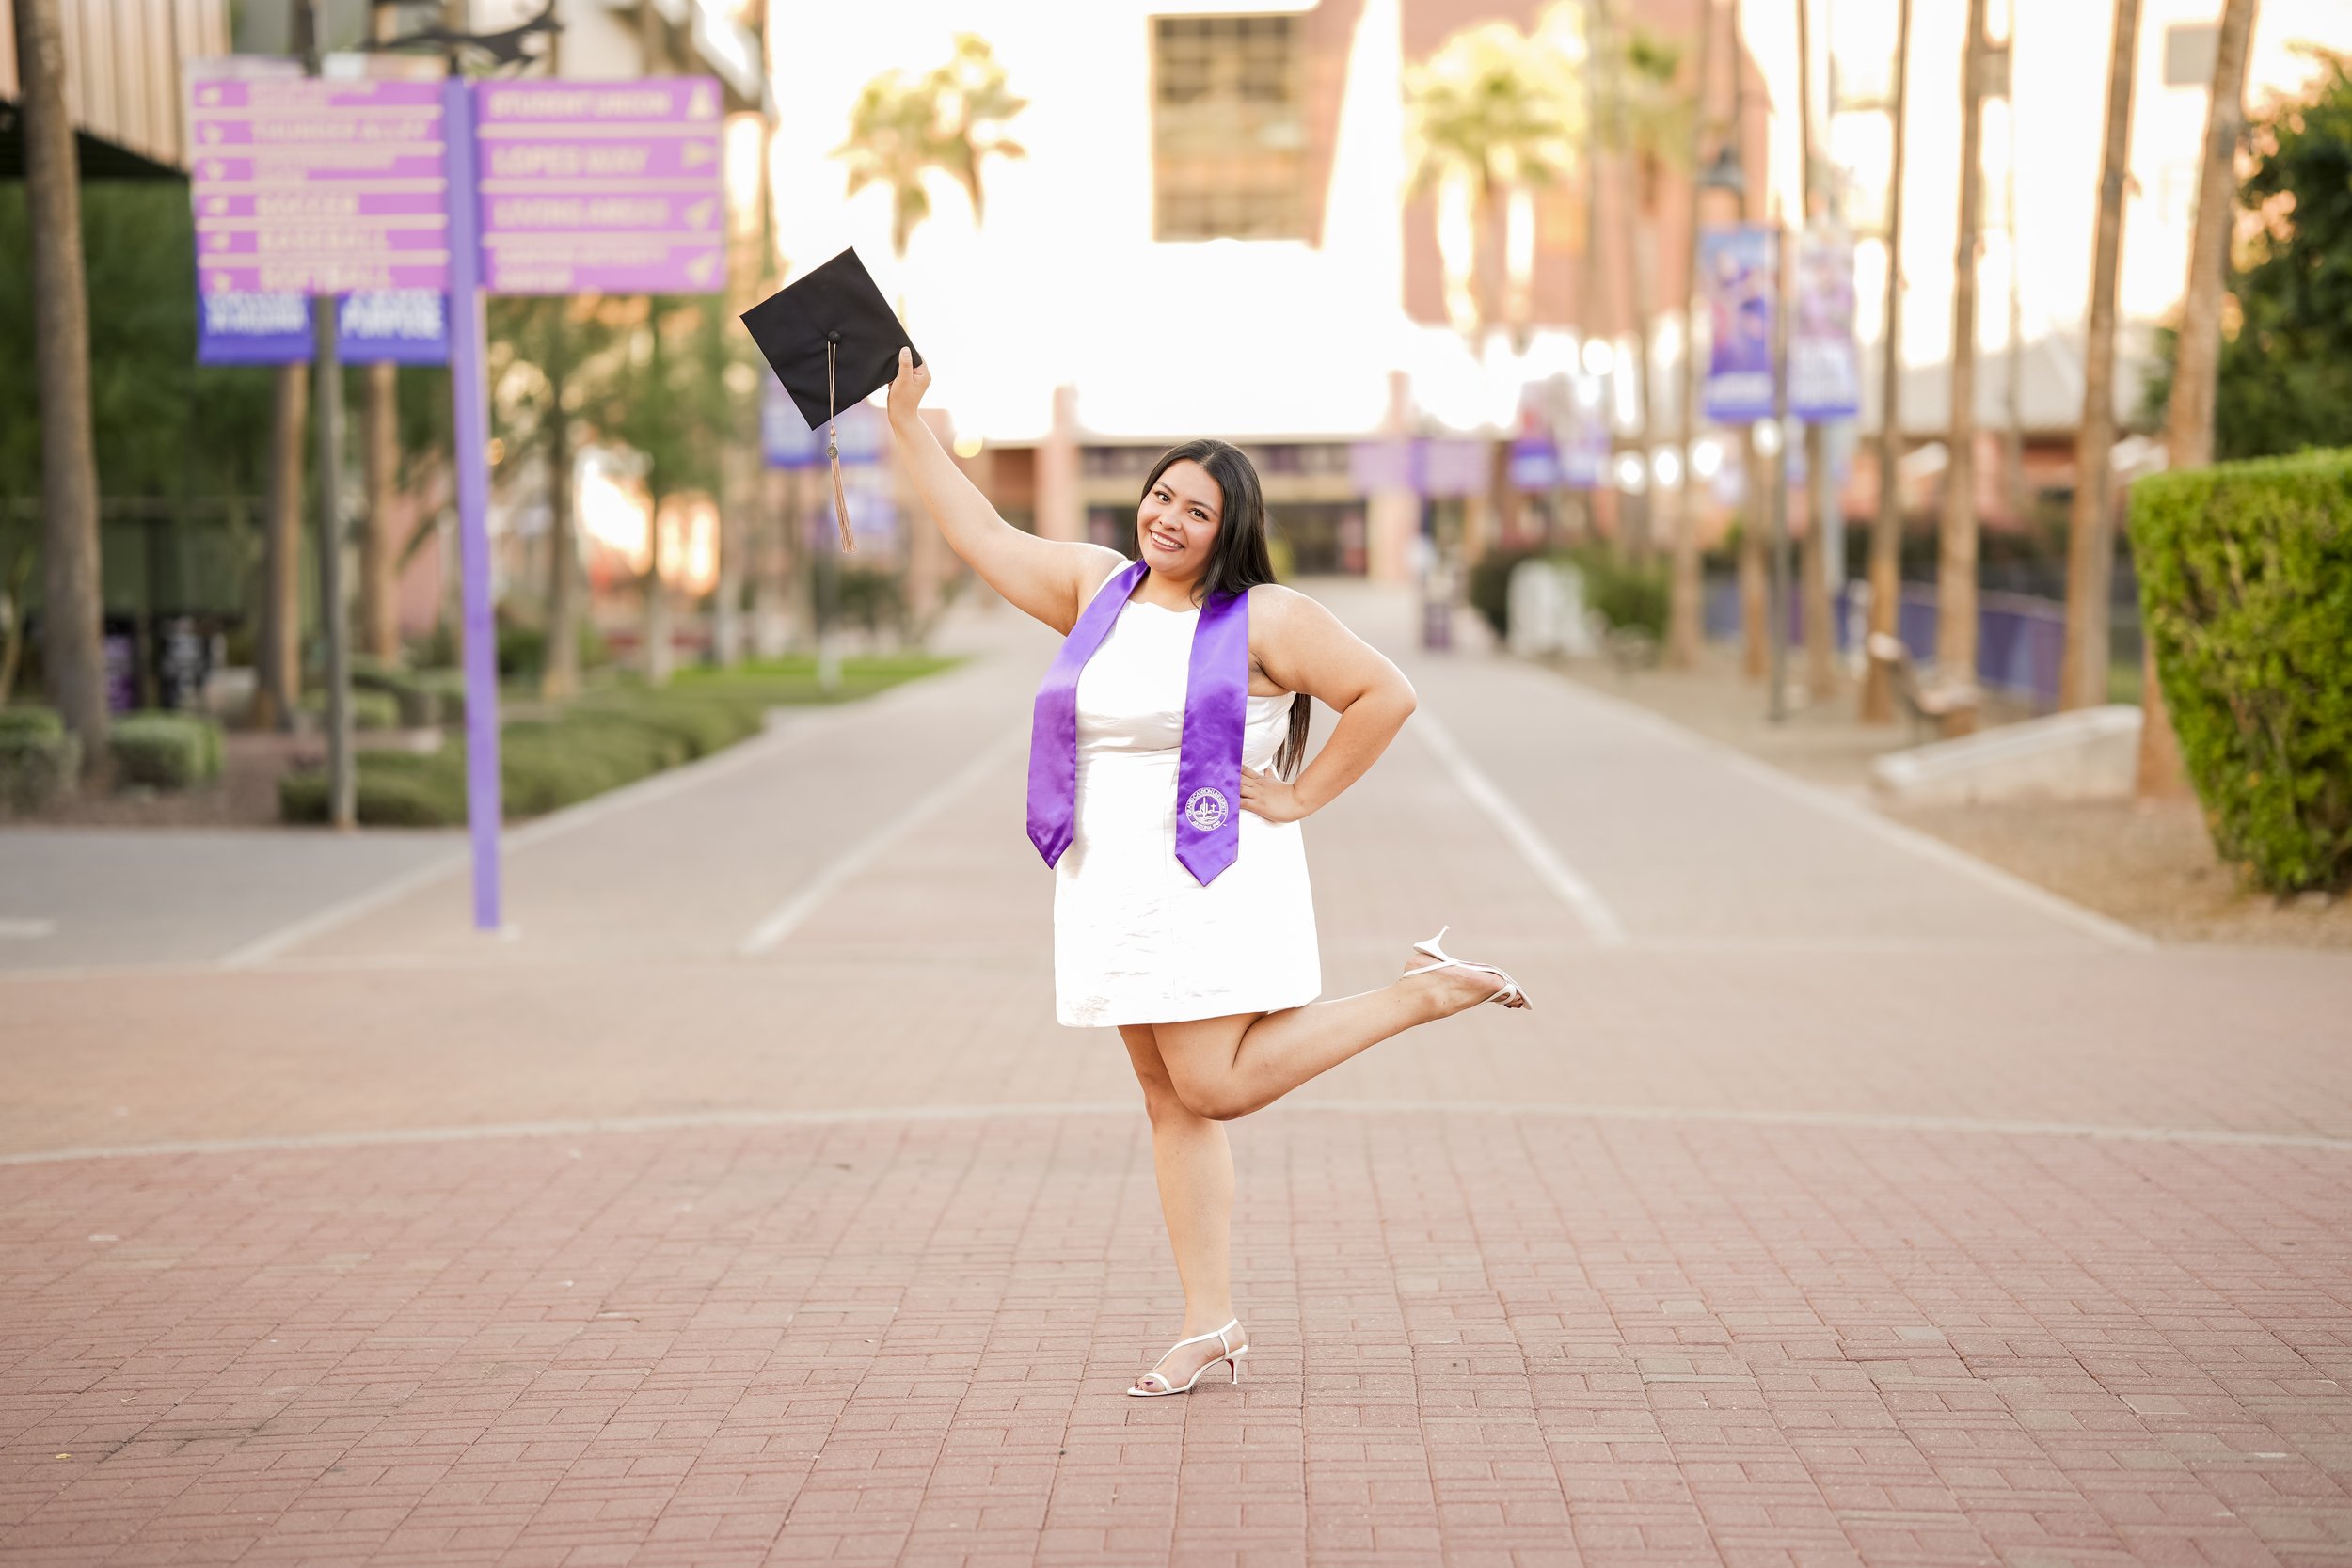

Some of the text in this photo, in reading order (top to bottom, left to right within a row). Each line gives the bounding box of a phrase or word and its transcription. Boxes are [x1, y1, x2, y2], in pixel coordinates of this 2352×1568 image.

[490, 91, 671, 116] STUDENT UNION
[493, 146, 649, 174] LOPES WAY
[257, 194, 358, 217] SOCCER
[259, 230, 389, 253] BASEBALL
